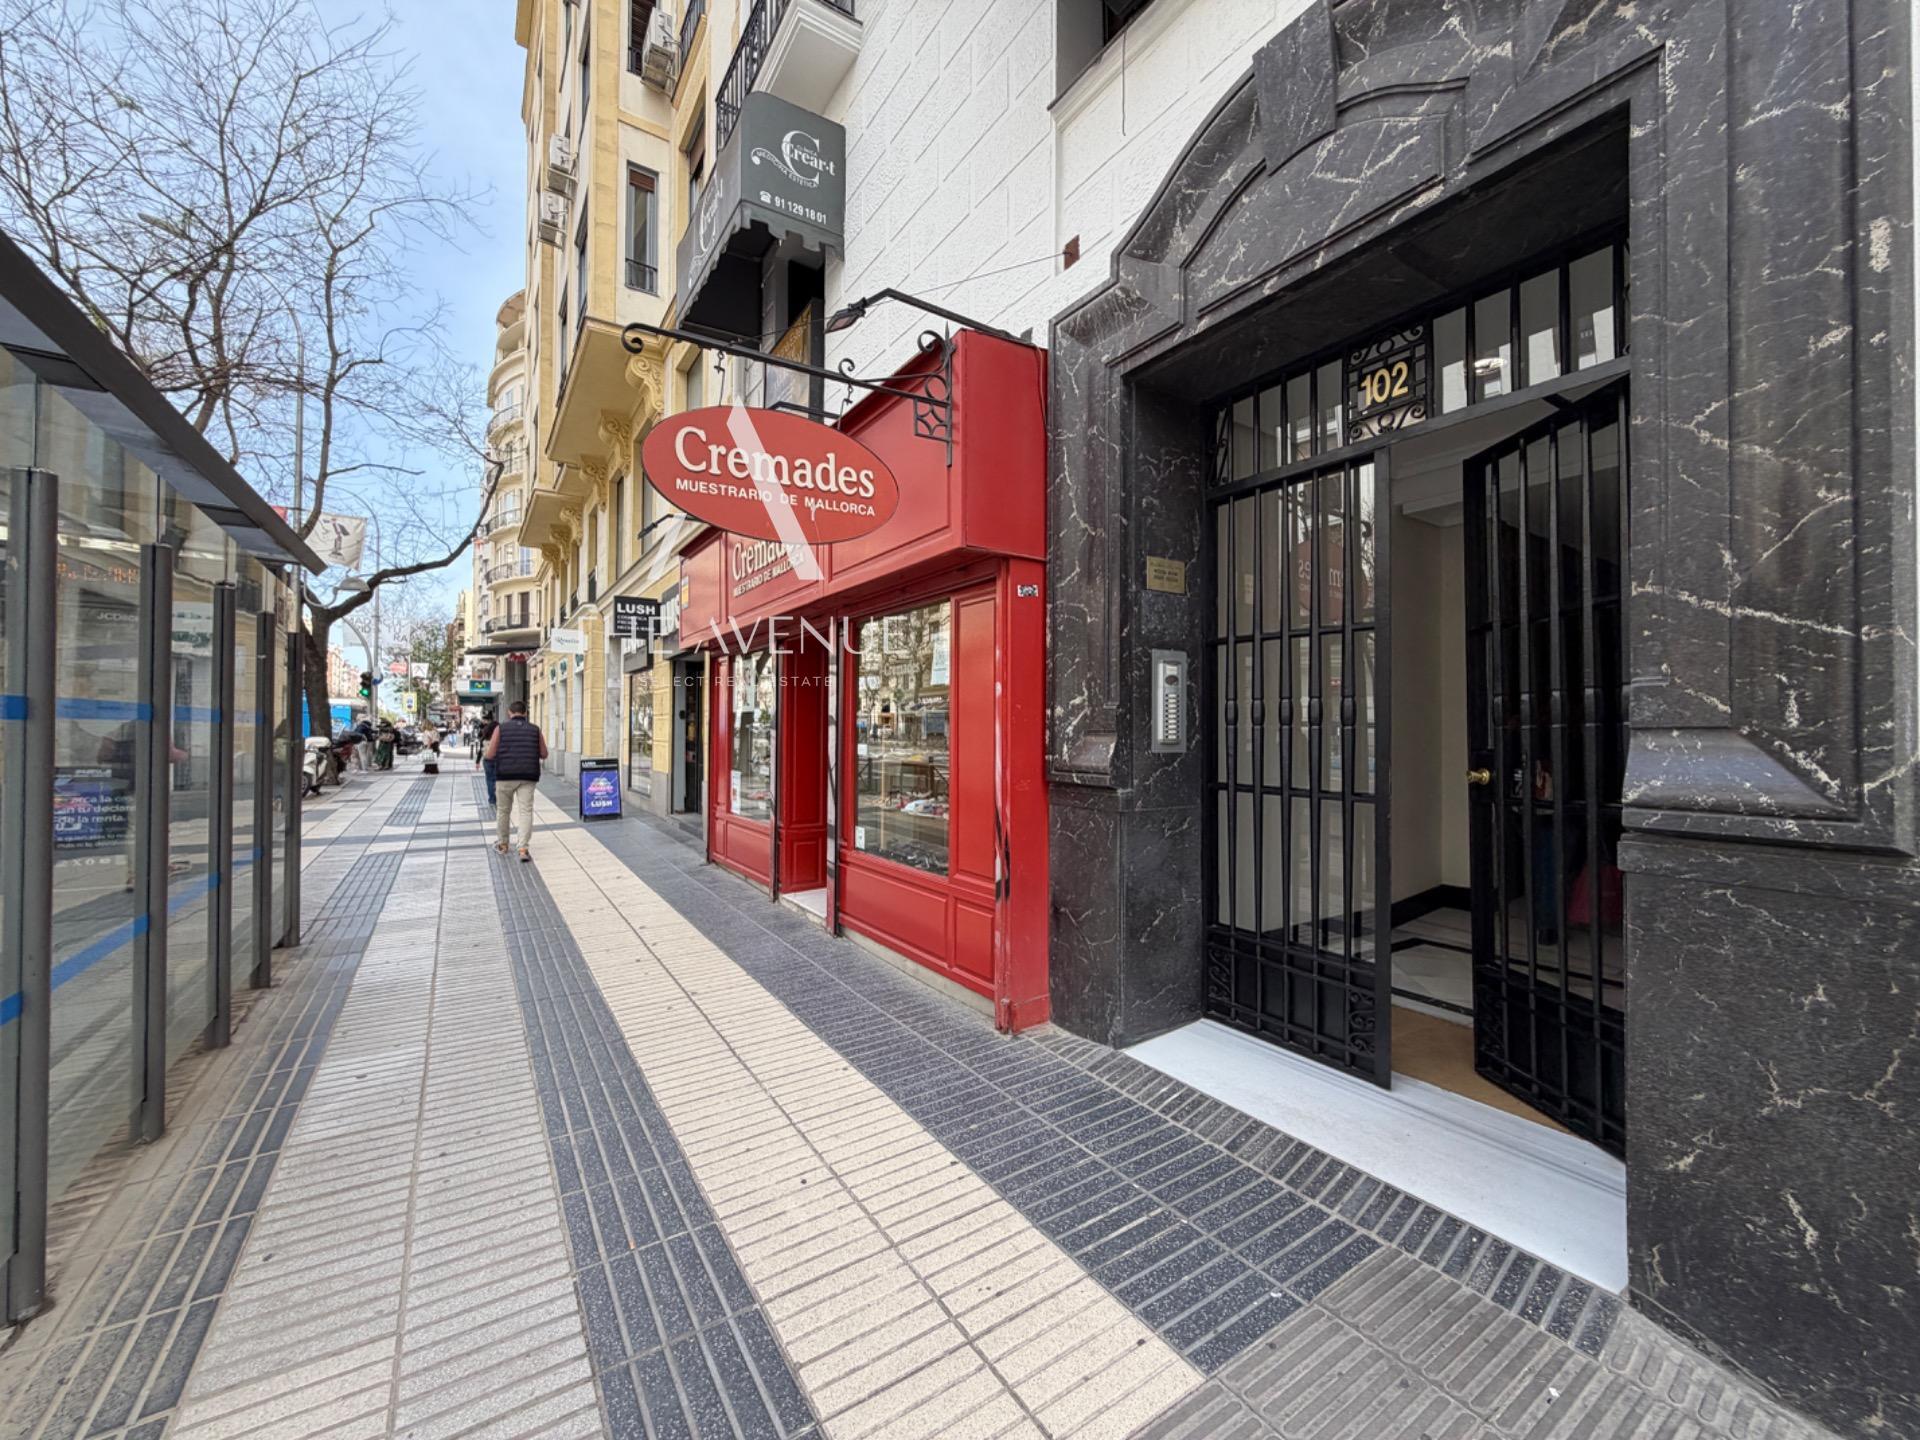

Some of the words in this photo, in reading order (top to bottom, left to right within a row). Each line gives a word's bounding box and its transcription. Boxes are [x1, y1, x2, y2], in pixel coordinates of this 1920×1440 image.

[774, 195, 785, 209] 91
[787, 201, 804, 216] 129
[816, 211, 827, 225] 01
[1361, 361, 1409, 406] 102
[675, 425, 876, 498] Cremades
[675, 478, 773, 502] MUESTRARIO
[780, 492, 798, 506] DE
[804, 496, 876, 516] MALLORCA
[616, 603, 656, 615] LUSH
